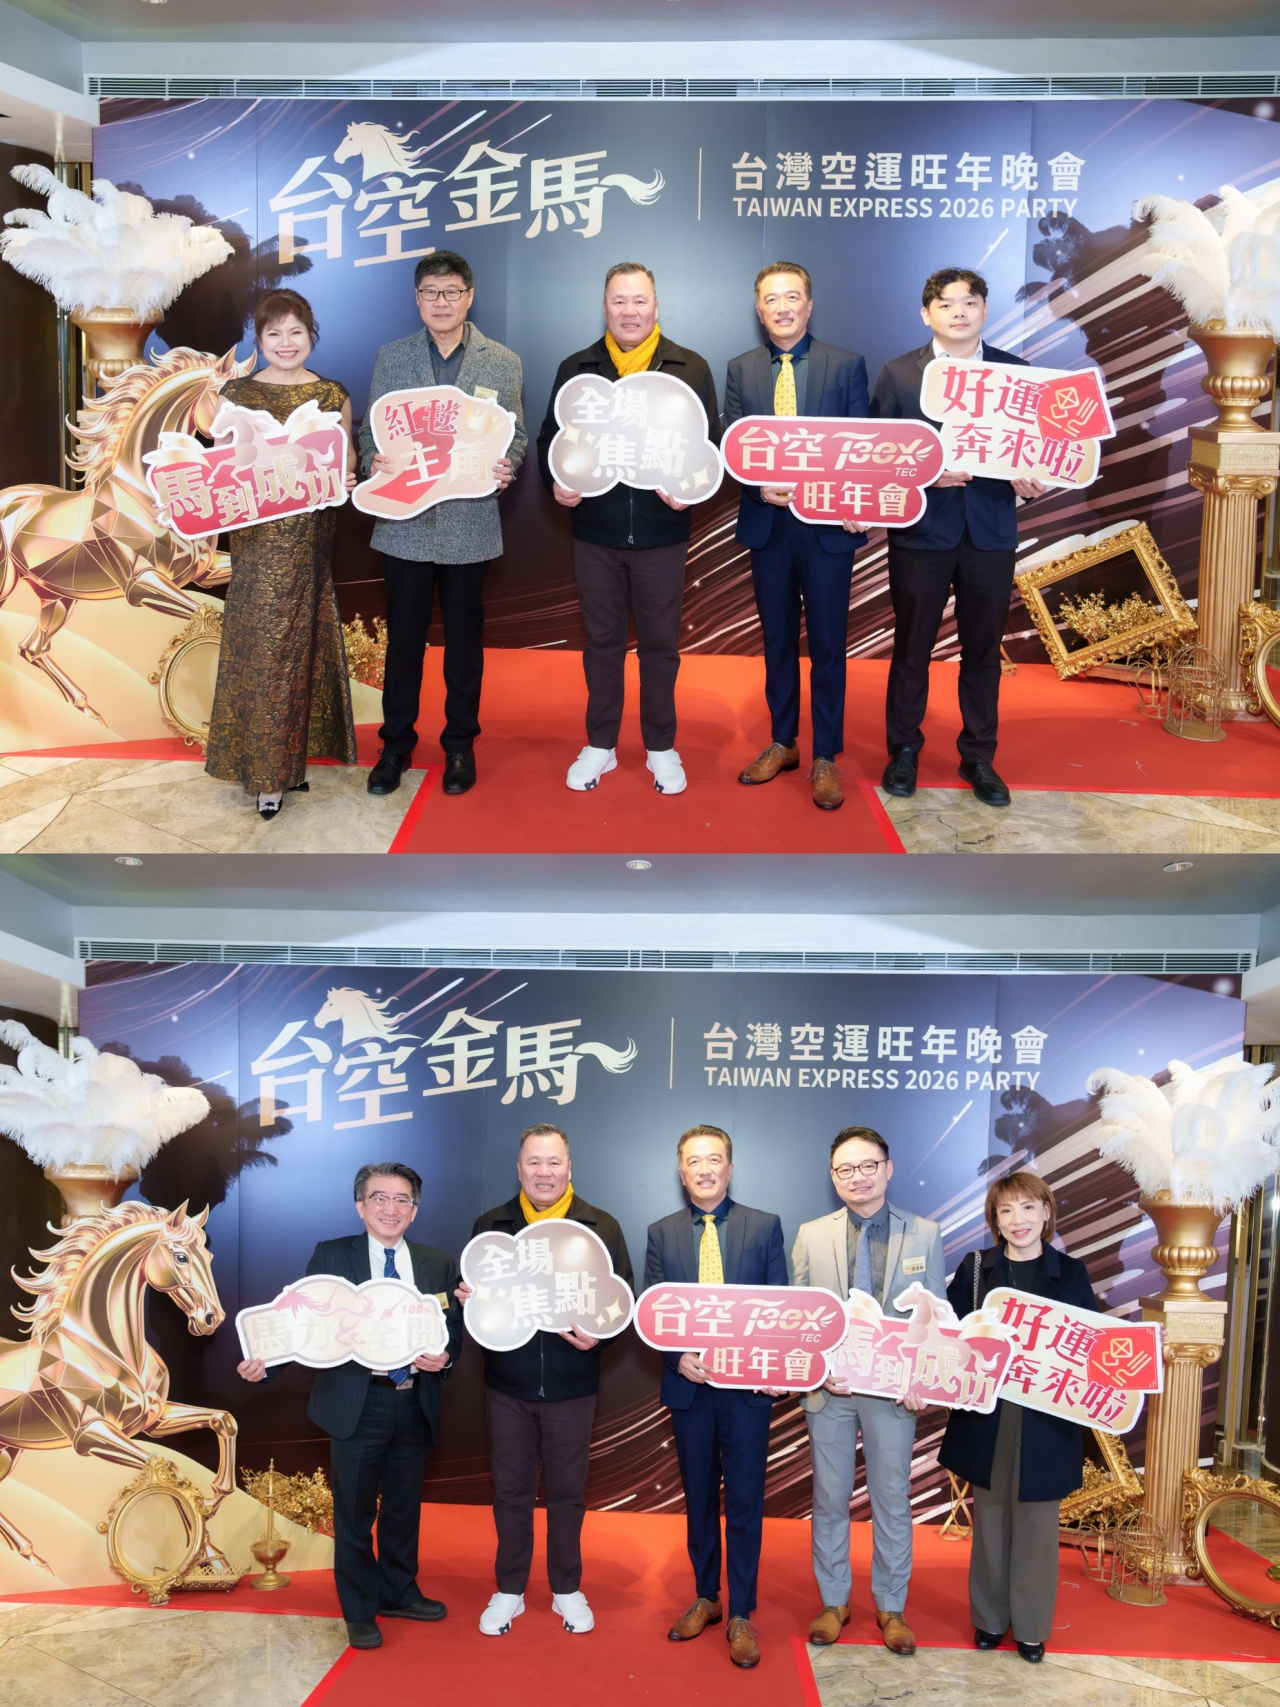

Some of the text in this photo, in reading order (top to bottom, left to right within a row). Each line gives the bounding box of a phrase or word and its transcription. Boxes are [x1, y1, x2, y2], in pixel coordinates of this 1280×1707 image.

[732, 151, 1086, 192] 台灣空運旺年晚會
[269, 139, 608, 268] 台空金馬
[732, 196, 1079, 220] TAIWAN EXPRESS 2026 PARTY
[571, 385, 650, 429] 全場
[941, 365, 1051, 425] 好運
[384, 398, 462, 441] 紅毯
[400, 440, 489, 488] 主角
[591, 426, 690, 481] 焦點
[738, 426, 828, 472] 台空
[951, 423, 1086, 484] 奔來啦
[153, 452, 344, 527] 馬到成功
[894, 467, 918, 478] TEC
[803, 480, 911, 518] 旺年會
[703, 1021, 1049, 1065] 台灣空運旺年晚會
[250, 1006, 584, 1131] 台空金馬
[704, 1066, 1041, 1092] TAIWAN EXPRESS 2026 PARTY
[477, 1237, 554, 1283] 全場
[508, 1270, 598, 1330] 焦點
[651, 1293, 737, 1338] 台空
[799, 1333, 822, 1343] TEC
[1001, 1296, 1107, 1368] 好運
[713, 1346, 815, 1381] 旺年會
[834, 1324, 998, 1410] 馬到成功
[1002, 1354, 1128, 1429] 奔來啦
